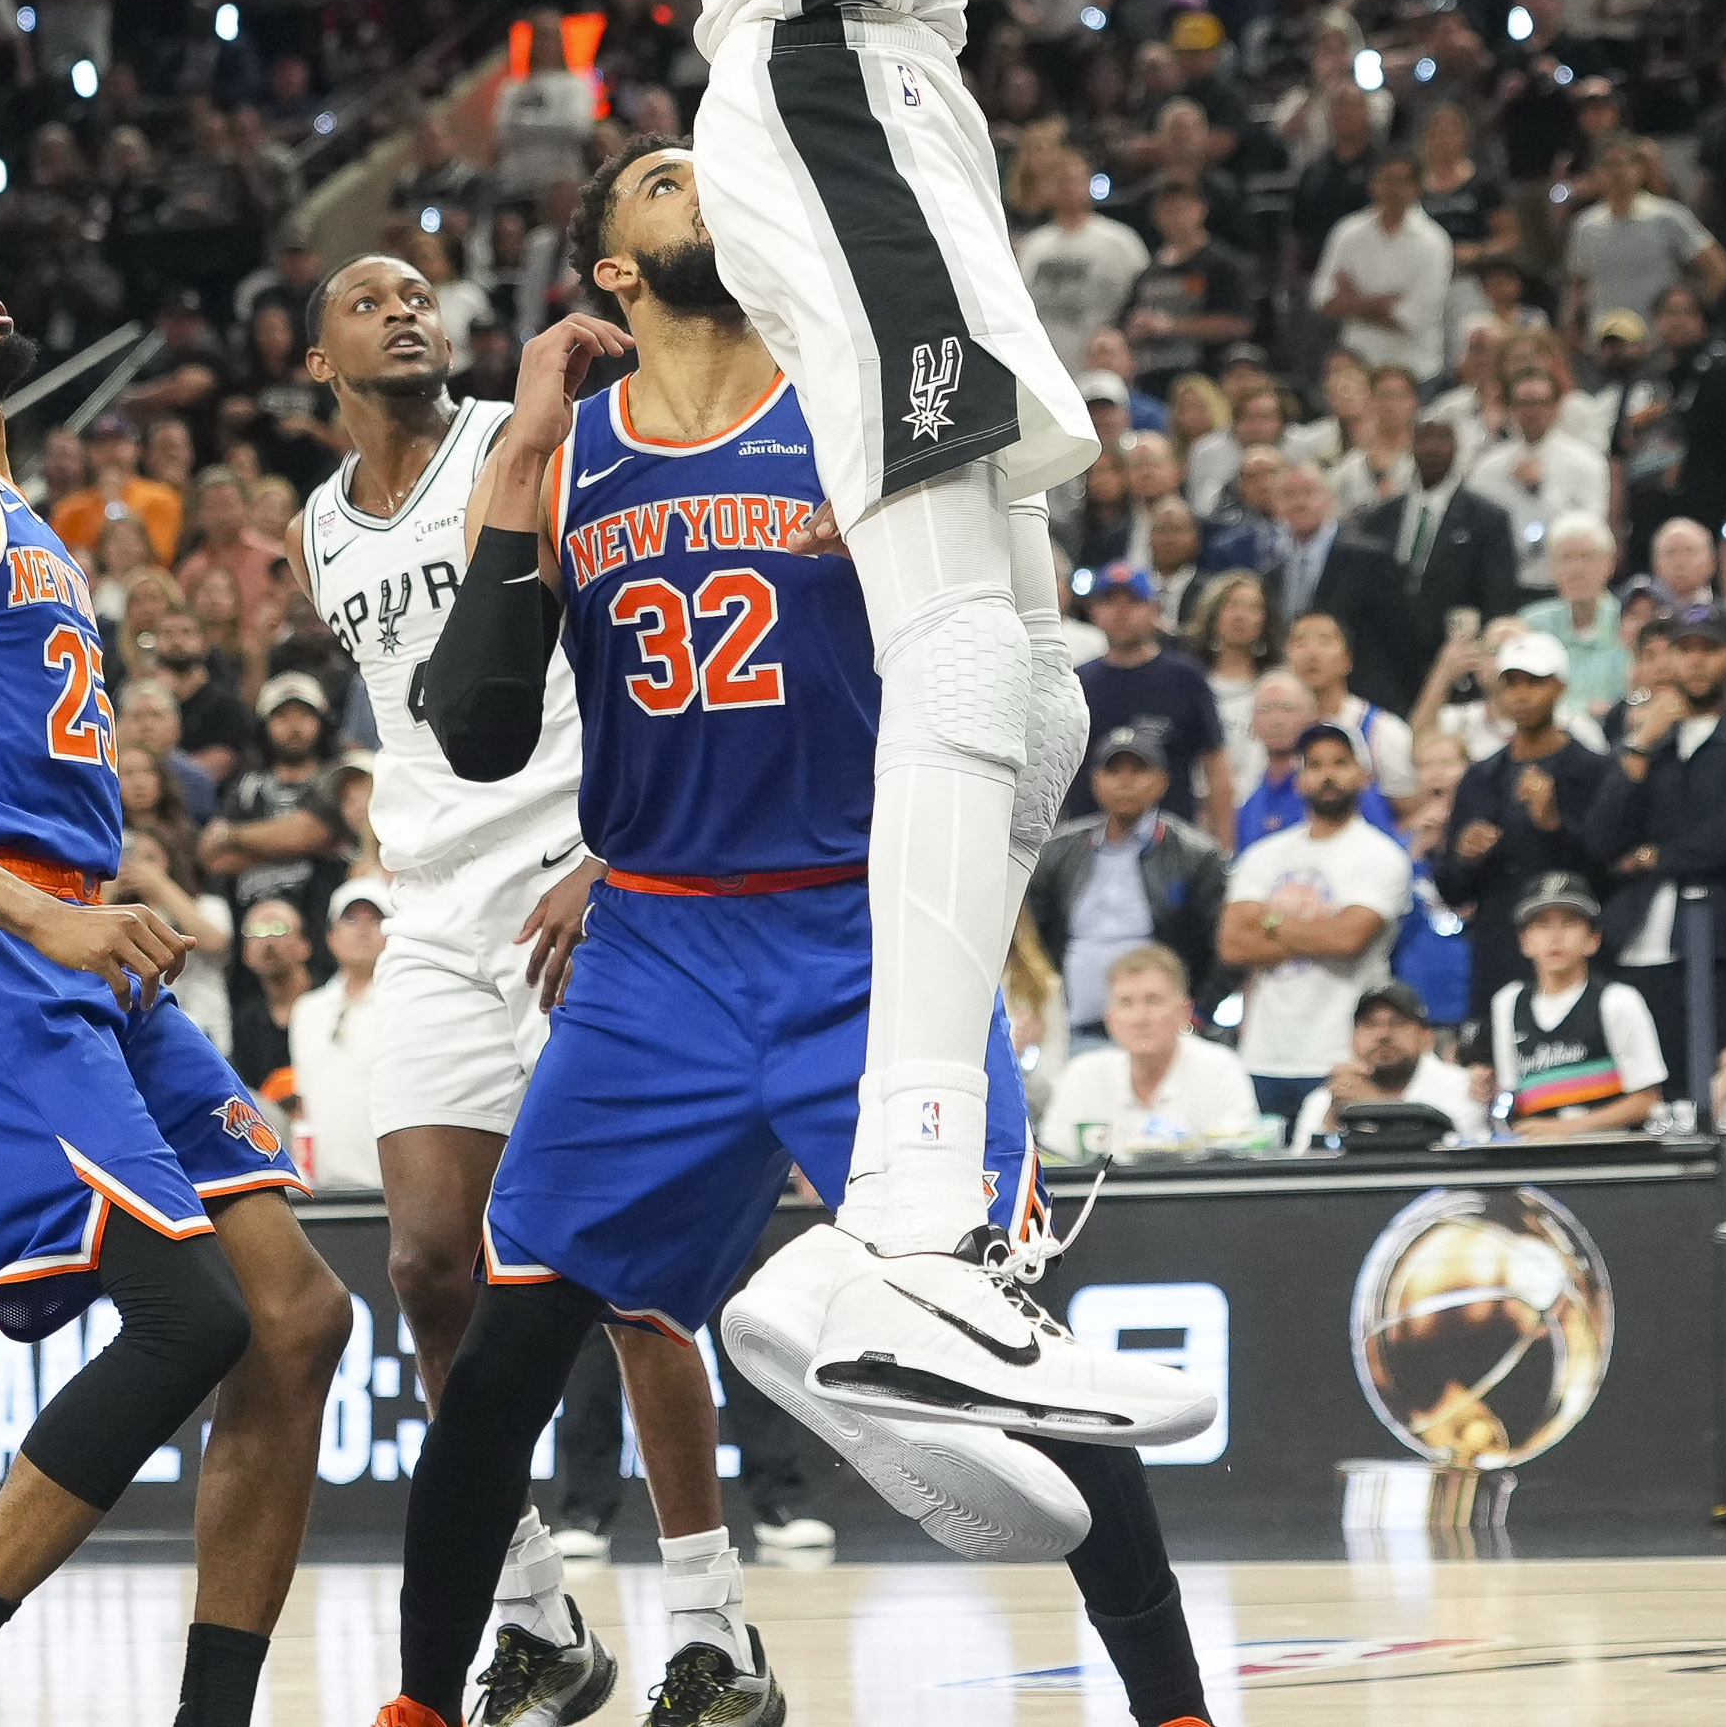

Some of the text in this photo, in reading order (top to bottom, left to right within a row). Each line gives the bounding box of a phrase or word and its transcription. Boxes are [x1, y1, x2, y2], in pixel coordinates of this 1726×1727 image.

[738, 443, 808, 456] abu dhabi
[6, 545, 74, 609] NEW
[566, 493, 819, 593] NEW YORK
[329, 560, 462, 656] SPUR
[608, 567, 786, 717] 32
